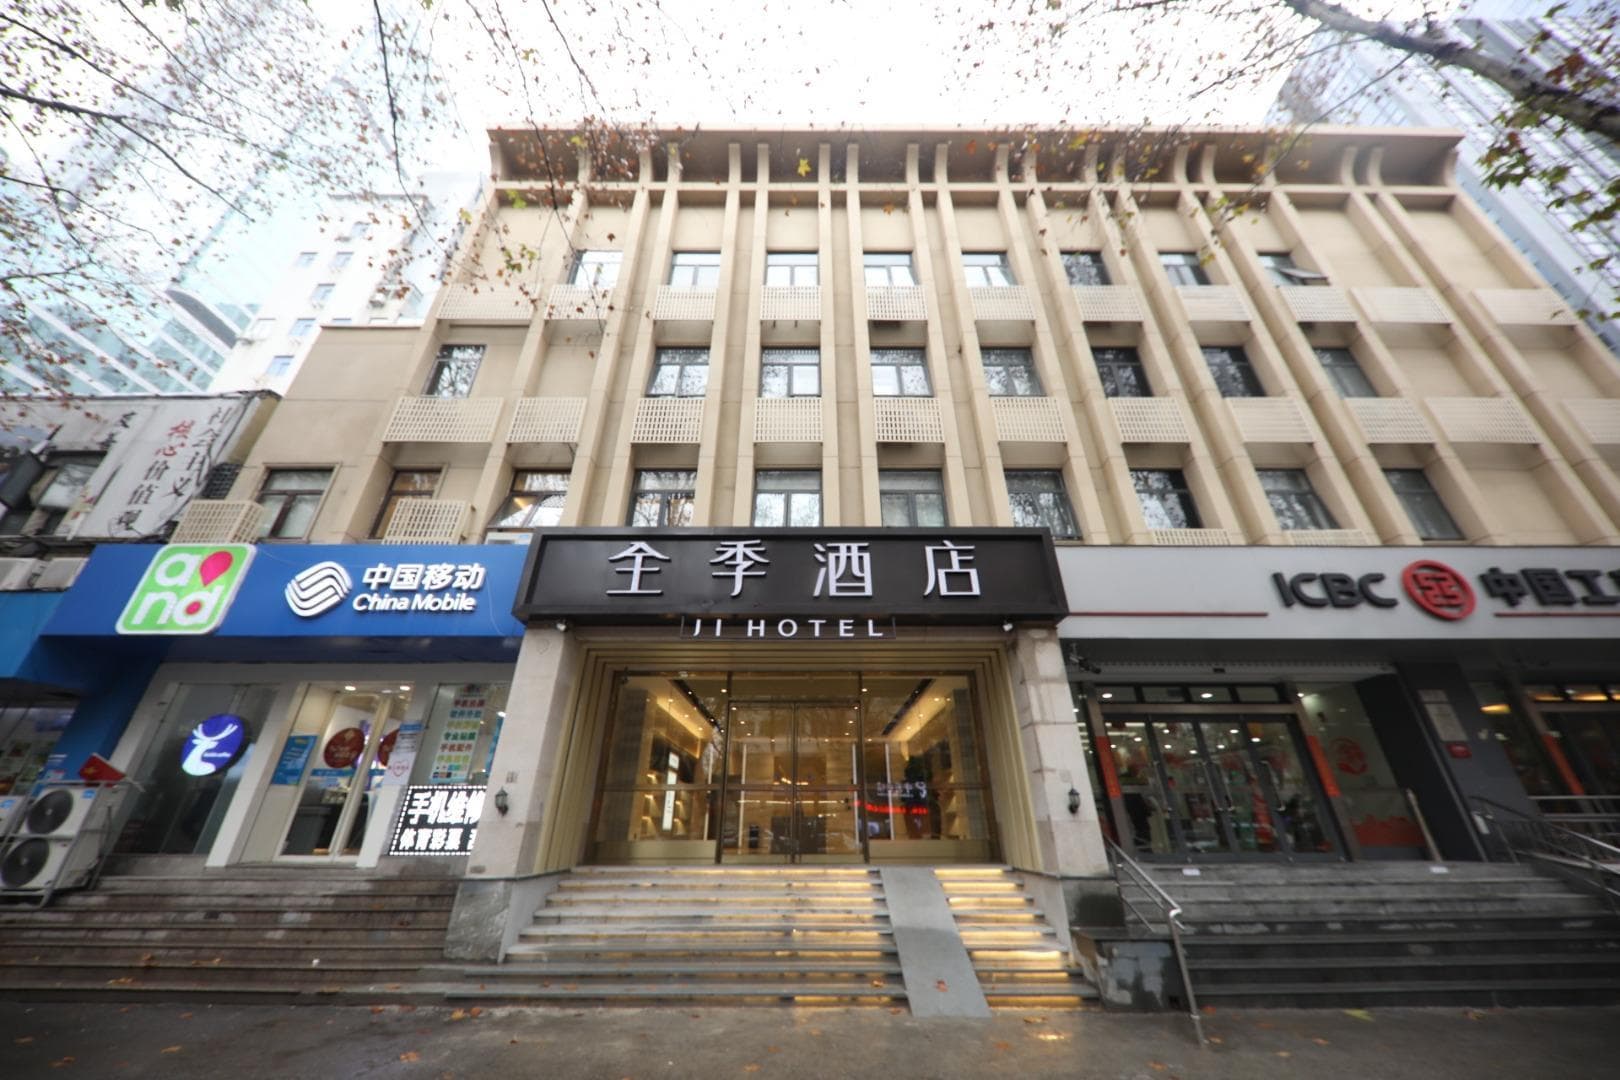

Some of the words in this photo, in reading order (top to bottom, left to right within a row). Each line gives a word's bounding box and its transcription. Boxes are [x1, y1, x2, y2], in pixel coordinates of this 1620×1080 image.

[362, 563, 486, 590] 中国移动
[606, 540, 981, 597] 全季酒店
[352, 592, 410, 611] China
[411, 592, 477, 611] Mobile
[1272, 572, 1399, 609] ICBC
[1477, 567, 1620, 607] 中国工
[693, 619, 722, 637] JI
[747, 618, 884, 637] HOTEL
